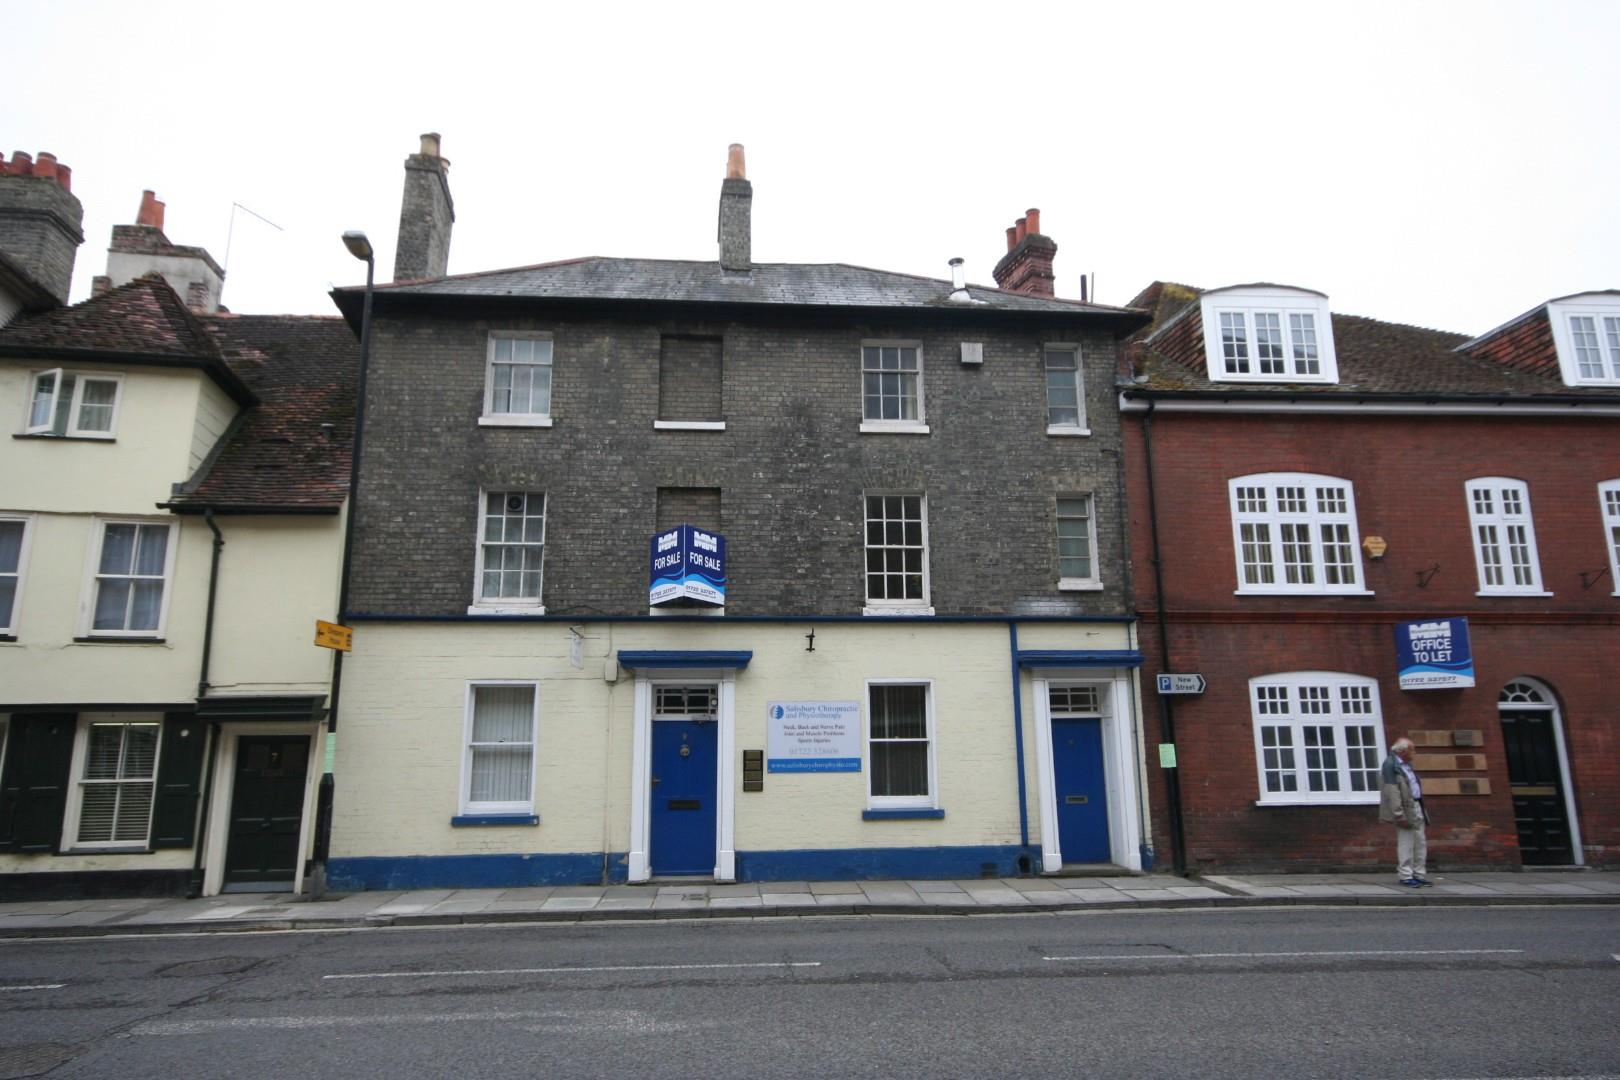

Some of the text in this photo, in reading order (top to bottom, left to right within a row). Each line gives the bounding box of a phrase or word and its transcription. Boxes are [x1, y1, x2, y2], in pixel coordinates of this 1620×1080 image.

[654, 552, 681, 571] FOR SALE
[689, 552, 721, 571] FOR SALE
[1411, 639, 1452, 652] OFFICE
[1412, 650, 1452, 664] TO LET
[1162, 677, 1170, 690] P
[785, 704, 858, 713] Salisbury Chiropractic
[798, 712, 842, 720] Physiotherapy
